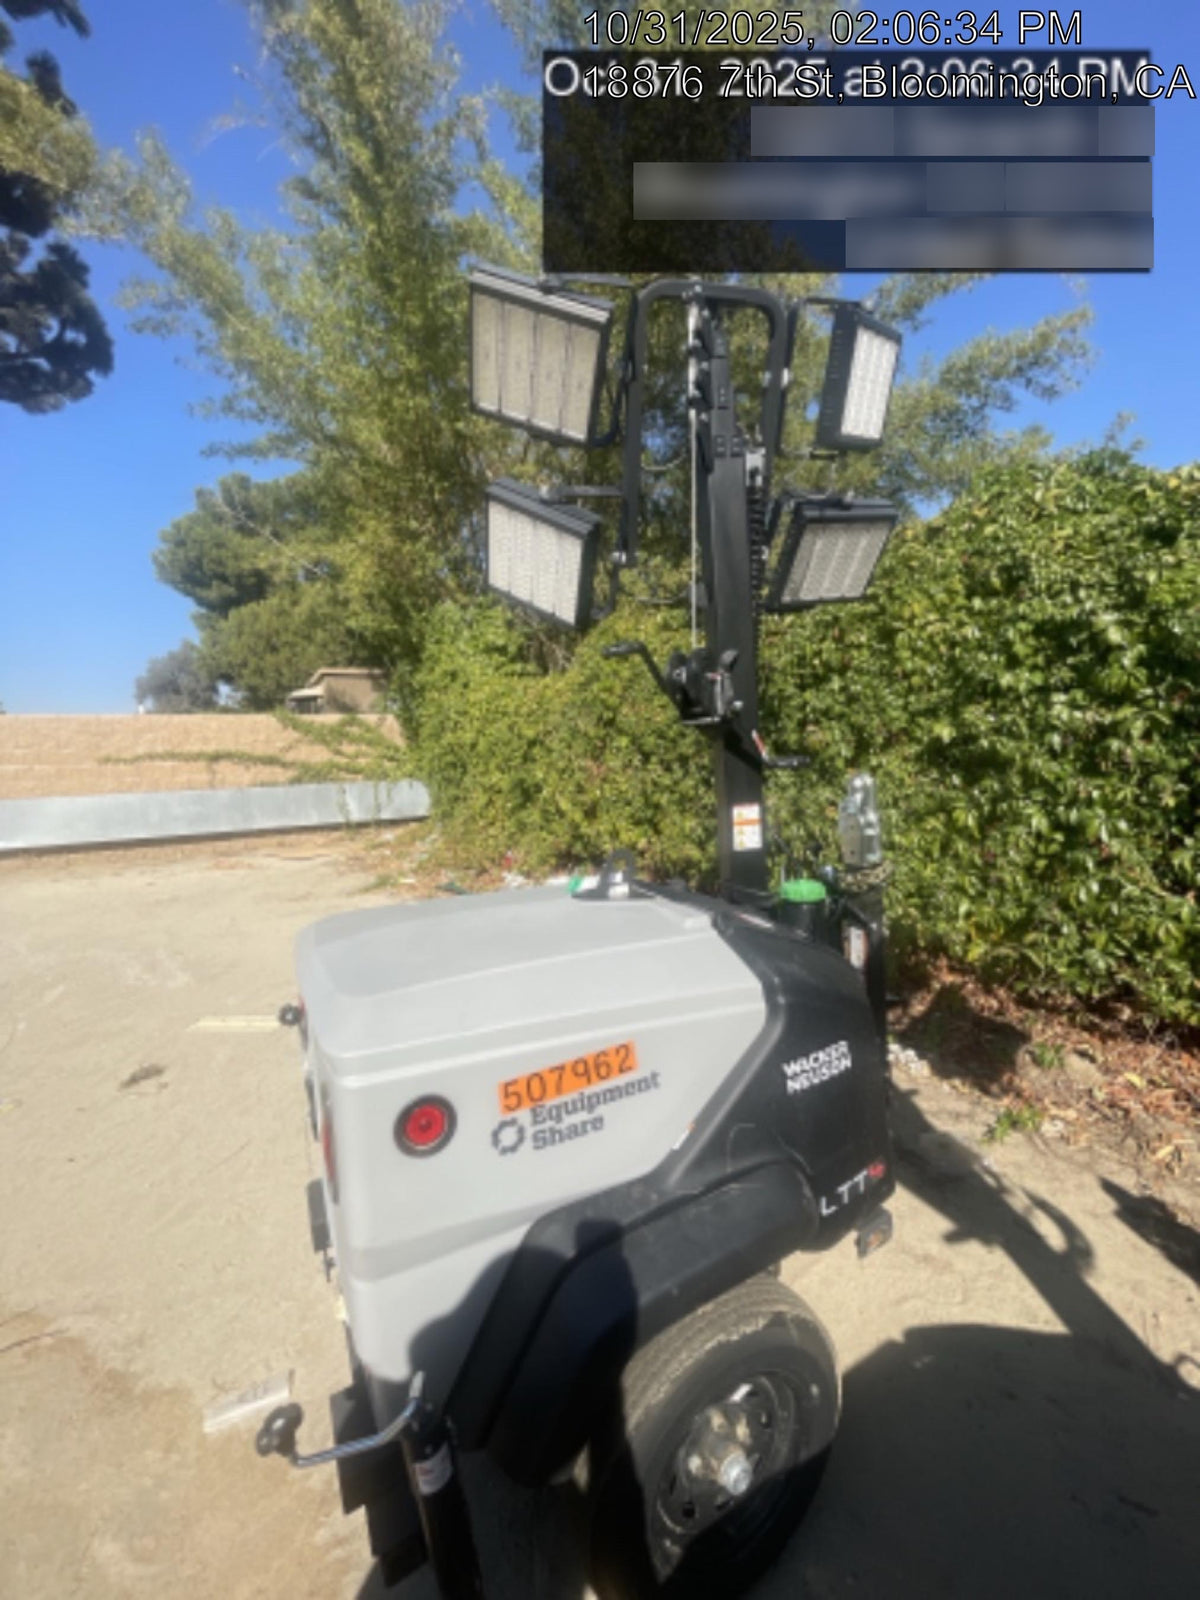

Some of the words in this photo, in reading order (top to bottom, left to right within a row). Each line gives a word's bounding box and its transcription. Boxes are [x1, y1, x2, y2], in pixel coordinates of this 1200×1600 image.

[503, 1043, 634, 1113] 507962
[529, 1070, 661, 1127] Equipment
[531, 1115, 605, 1150] Share
